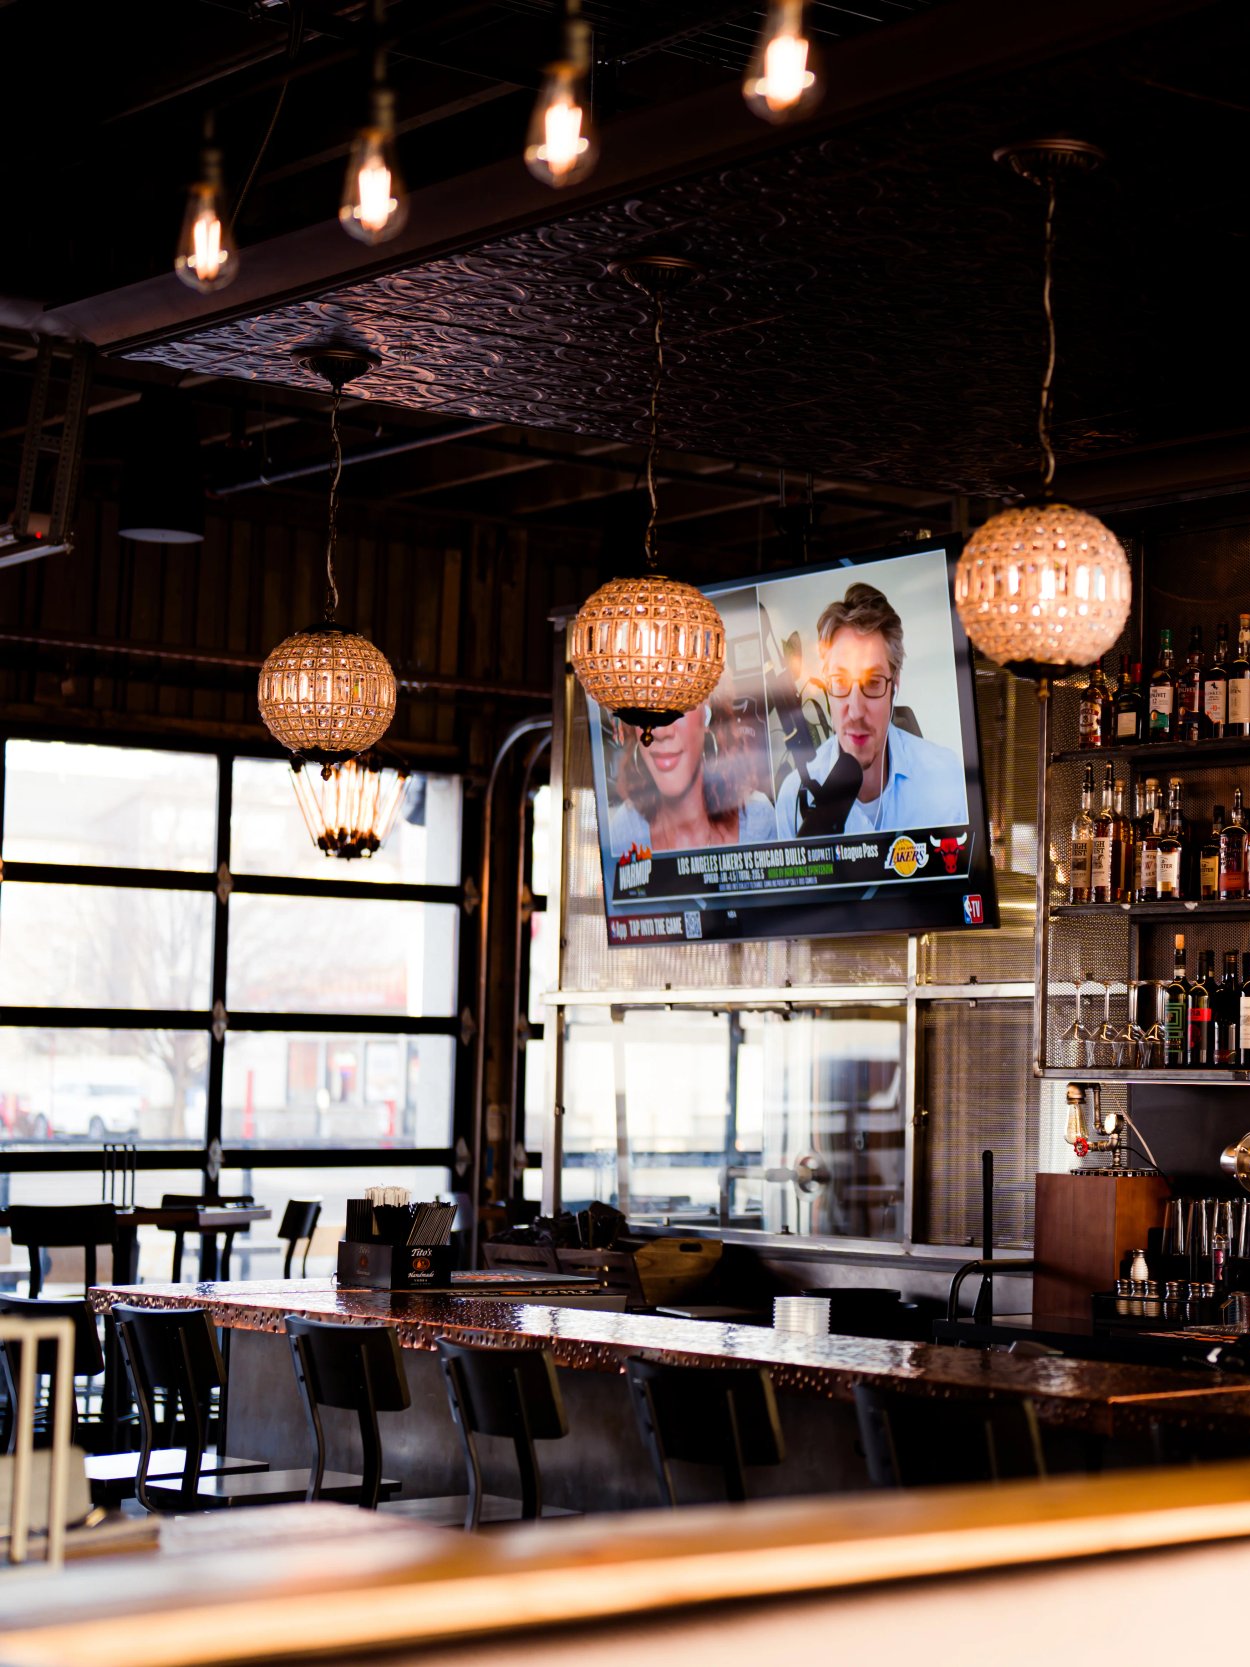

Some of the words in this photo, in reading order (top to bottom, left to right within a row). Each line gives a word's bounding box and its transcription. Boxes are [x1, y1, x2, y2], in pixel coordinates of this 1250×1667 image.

[677, 857, 690, 875] LOS
[690, 854, 718, 874] ANGELES
[718, 852, 744, 872] LAKERS
[743, 850, 754, 870] VS
[754, 848, 784, 869] CHICAGO
[784, 846, 806, 866] BULLS
[840, 844, 862, 862] League
[862, 842, 878, 858] Pass
[889, 848, 925, 866] LAKERS
[619, 859, 652, 891] WARMUP
[971, 900, 980, 918] TV
[666, 916, 683, 934] GAME
[411, 1248, 433, 1257] Tito's
